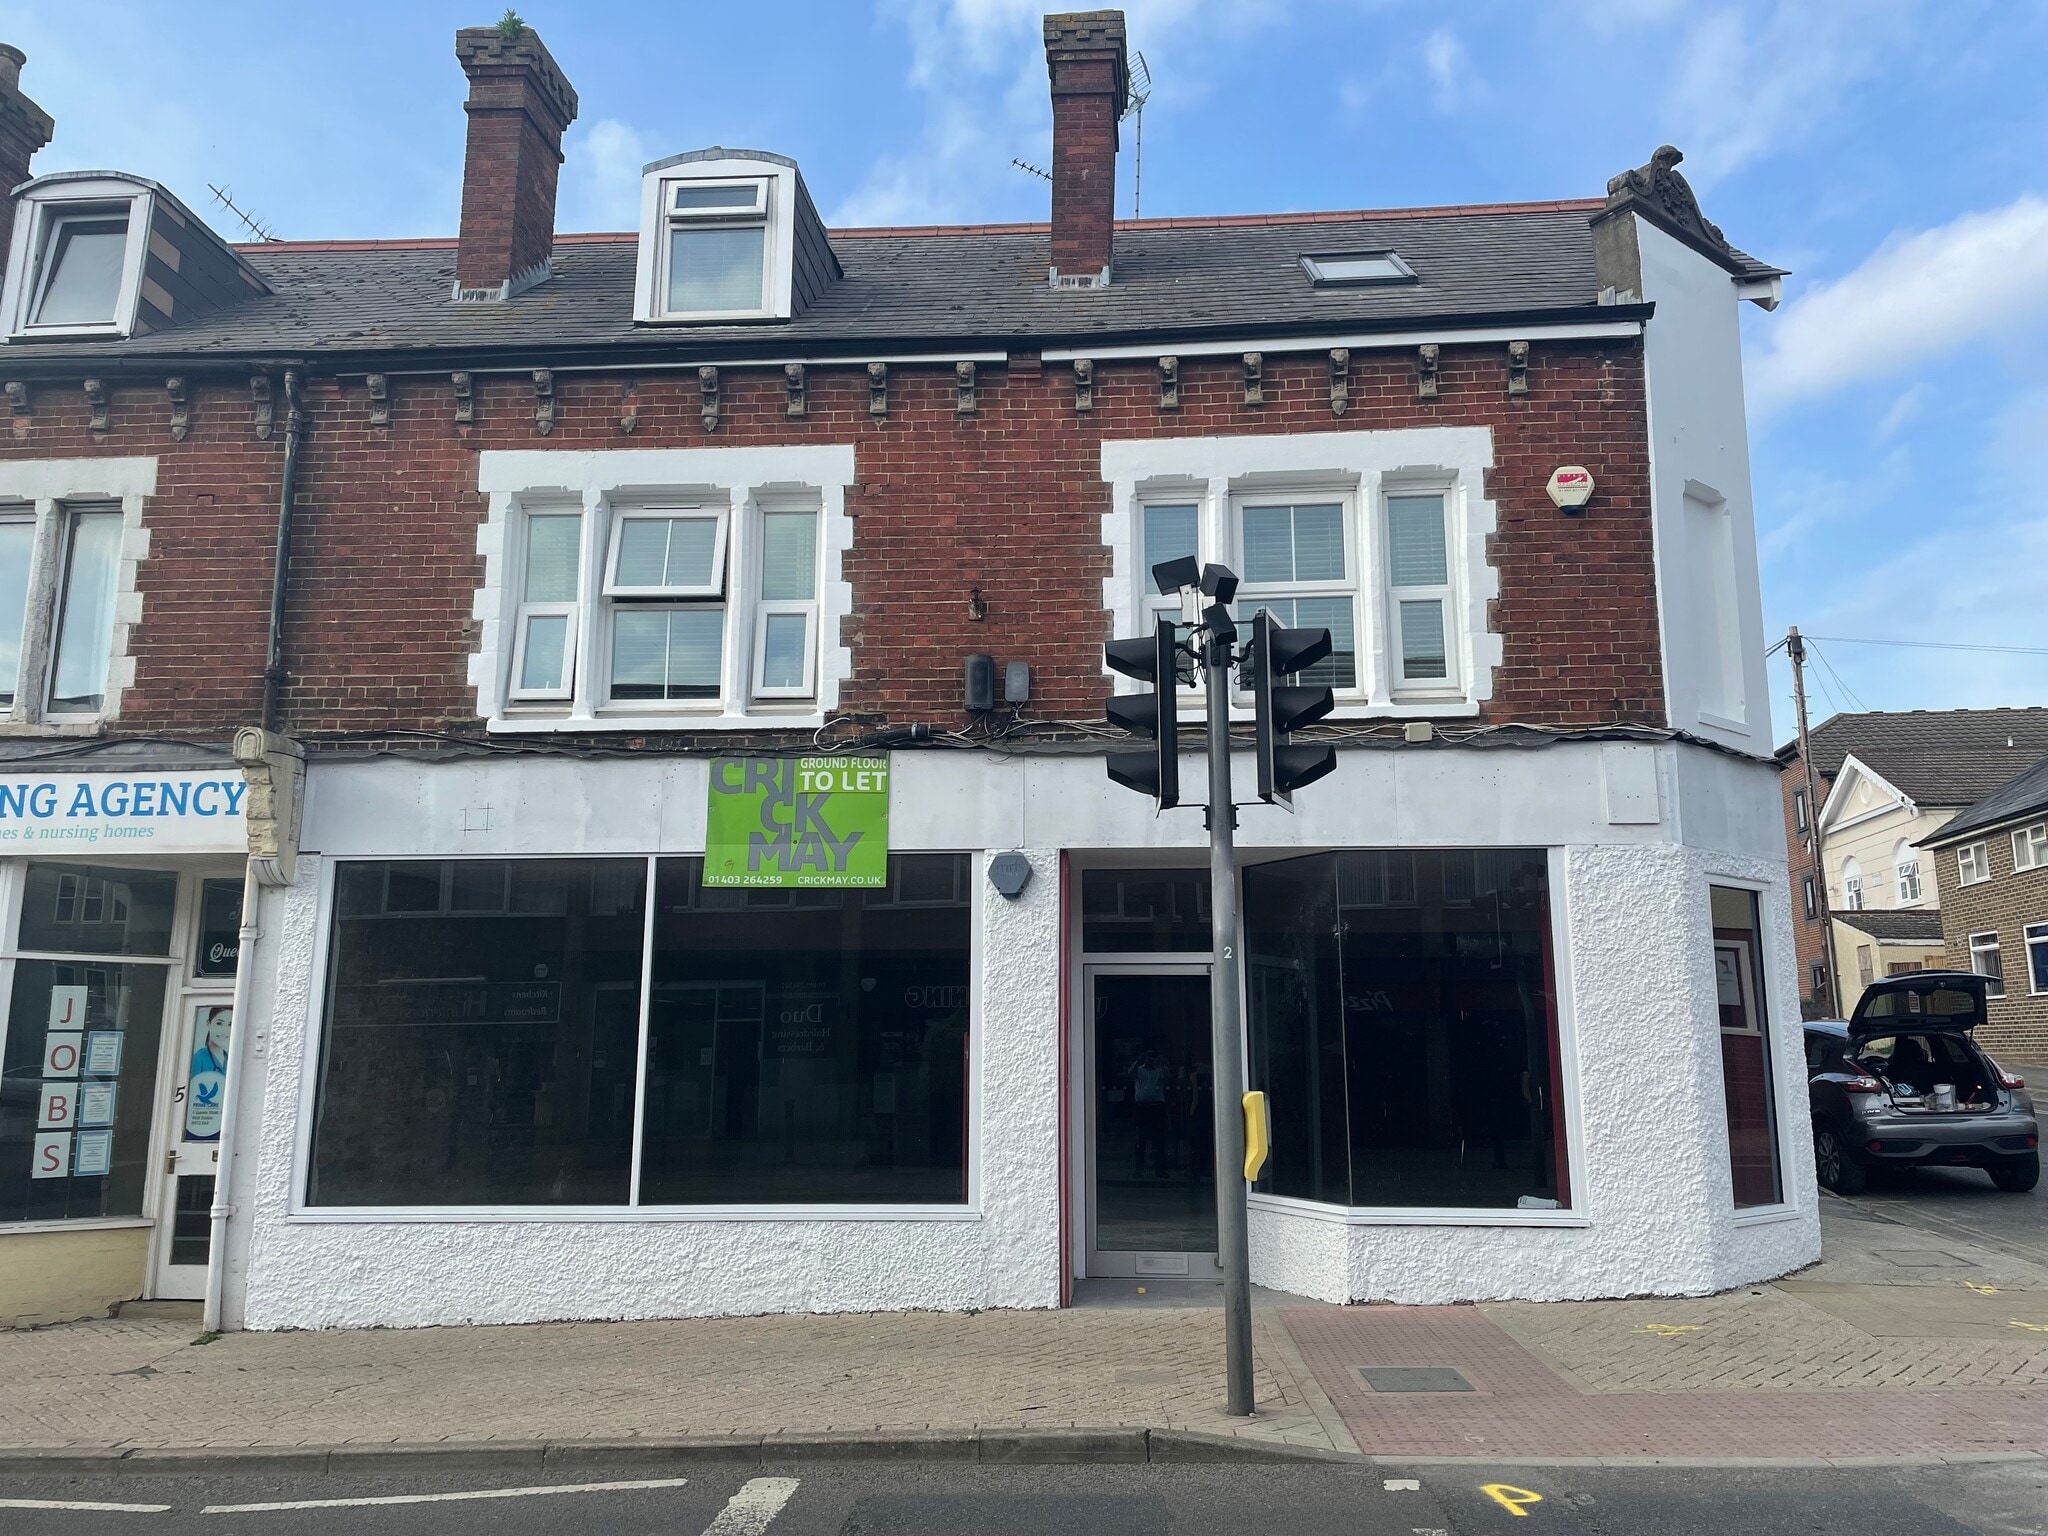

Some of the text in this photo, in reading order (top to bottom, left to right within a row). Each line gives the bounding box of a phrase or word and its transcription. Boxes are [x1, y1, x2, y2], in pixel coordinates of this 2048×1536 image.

[800, 757, 887, 769] GROUND FLOOR
[800, 771, 887, 791] TO LET
[66, 781, 248, 817] AGENCY
[23, 826, 35, 839] &
[39, 824, 98, 842] nursing
[103, 824, 155, 838] homes
[747, 831, 866, 872] MAY
[708, 875, 882, 885] 01403 264259 CRICKMAY.CO.UK
[209, 942, 240, 963] Que
[1223, 945, 1233, 959] 2
[174, 1086, 186, 1103] 5
